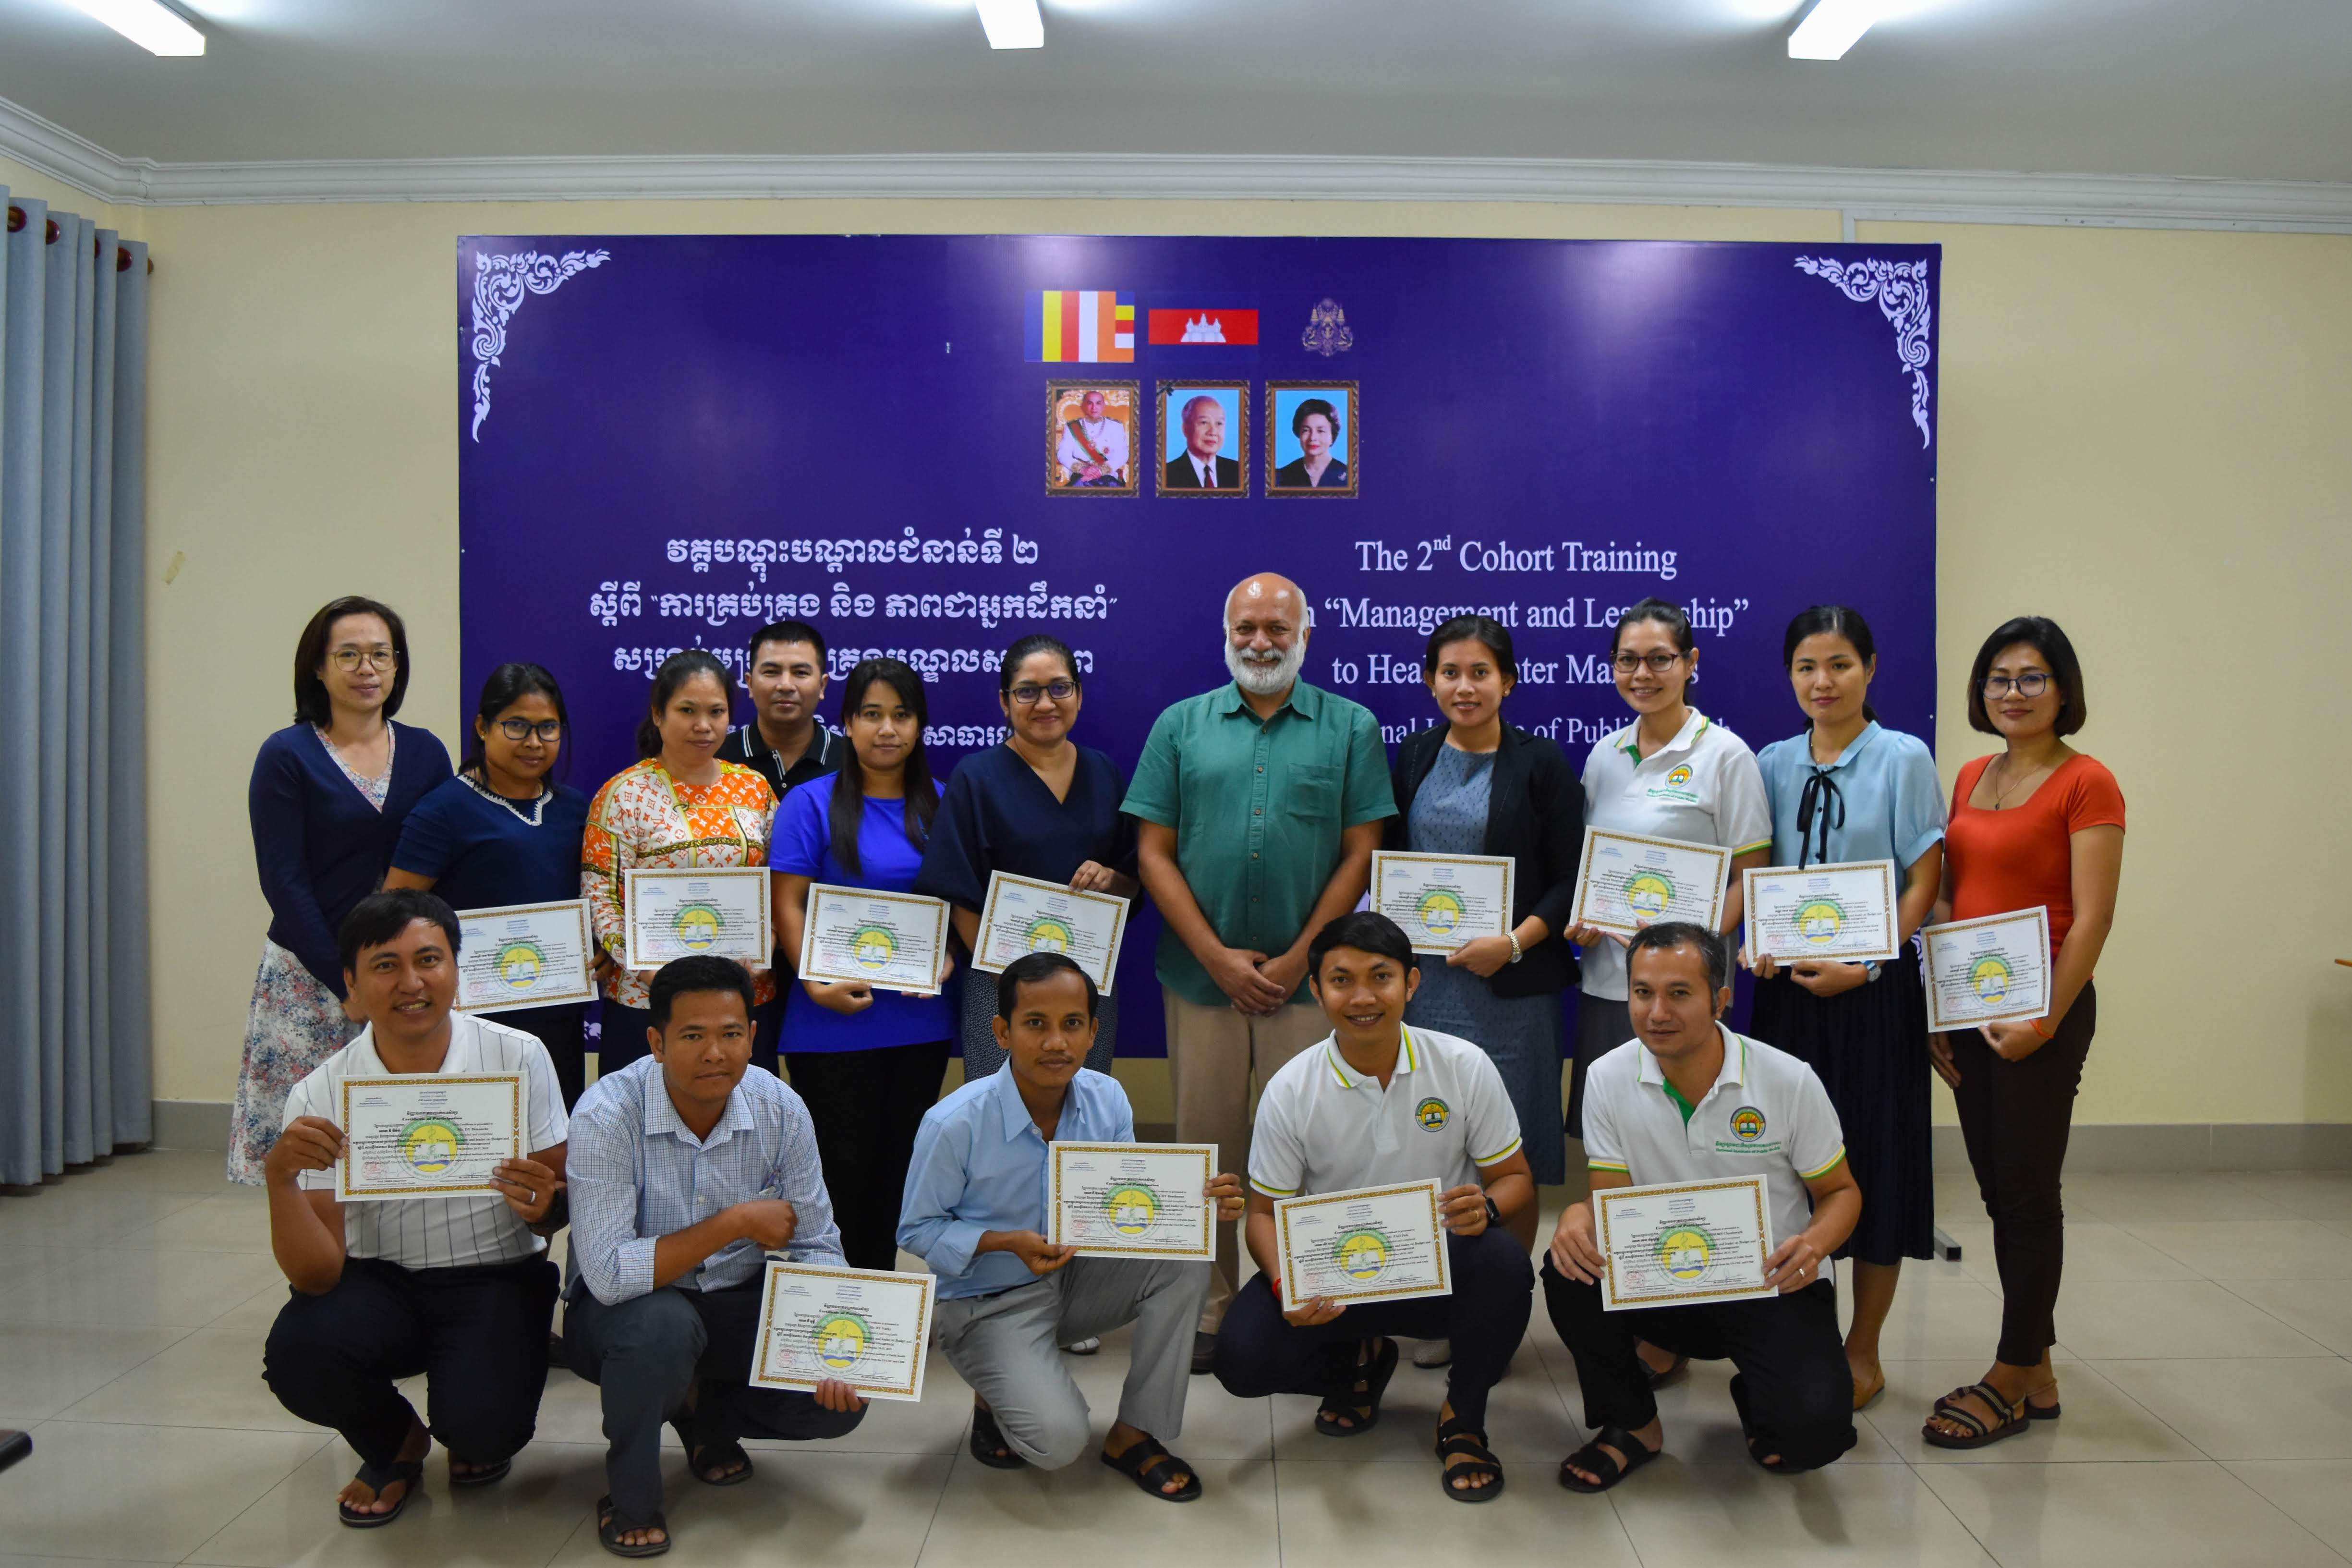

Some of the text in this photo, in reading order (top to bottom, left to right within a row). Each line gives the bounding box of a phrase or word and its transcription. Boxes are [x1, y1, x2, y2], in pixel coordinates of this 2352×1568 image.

[1013, 534, 1038, 564] ២
[1355, 541, 1407, 571] The
[1460, 541, 1554, 571] Cohort
[1562, 541, 1677, 580] Training
[831, 581, 874, 617] និង
[1527, 597, 1576, 627] and
[1332, 658, 1358, 684] to
[1368, 655, 1426, 684] Hea
[1534, 717, 1562, 740] of
